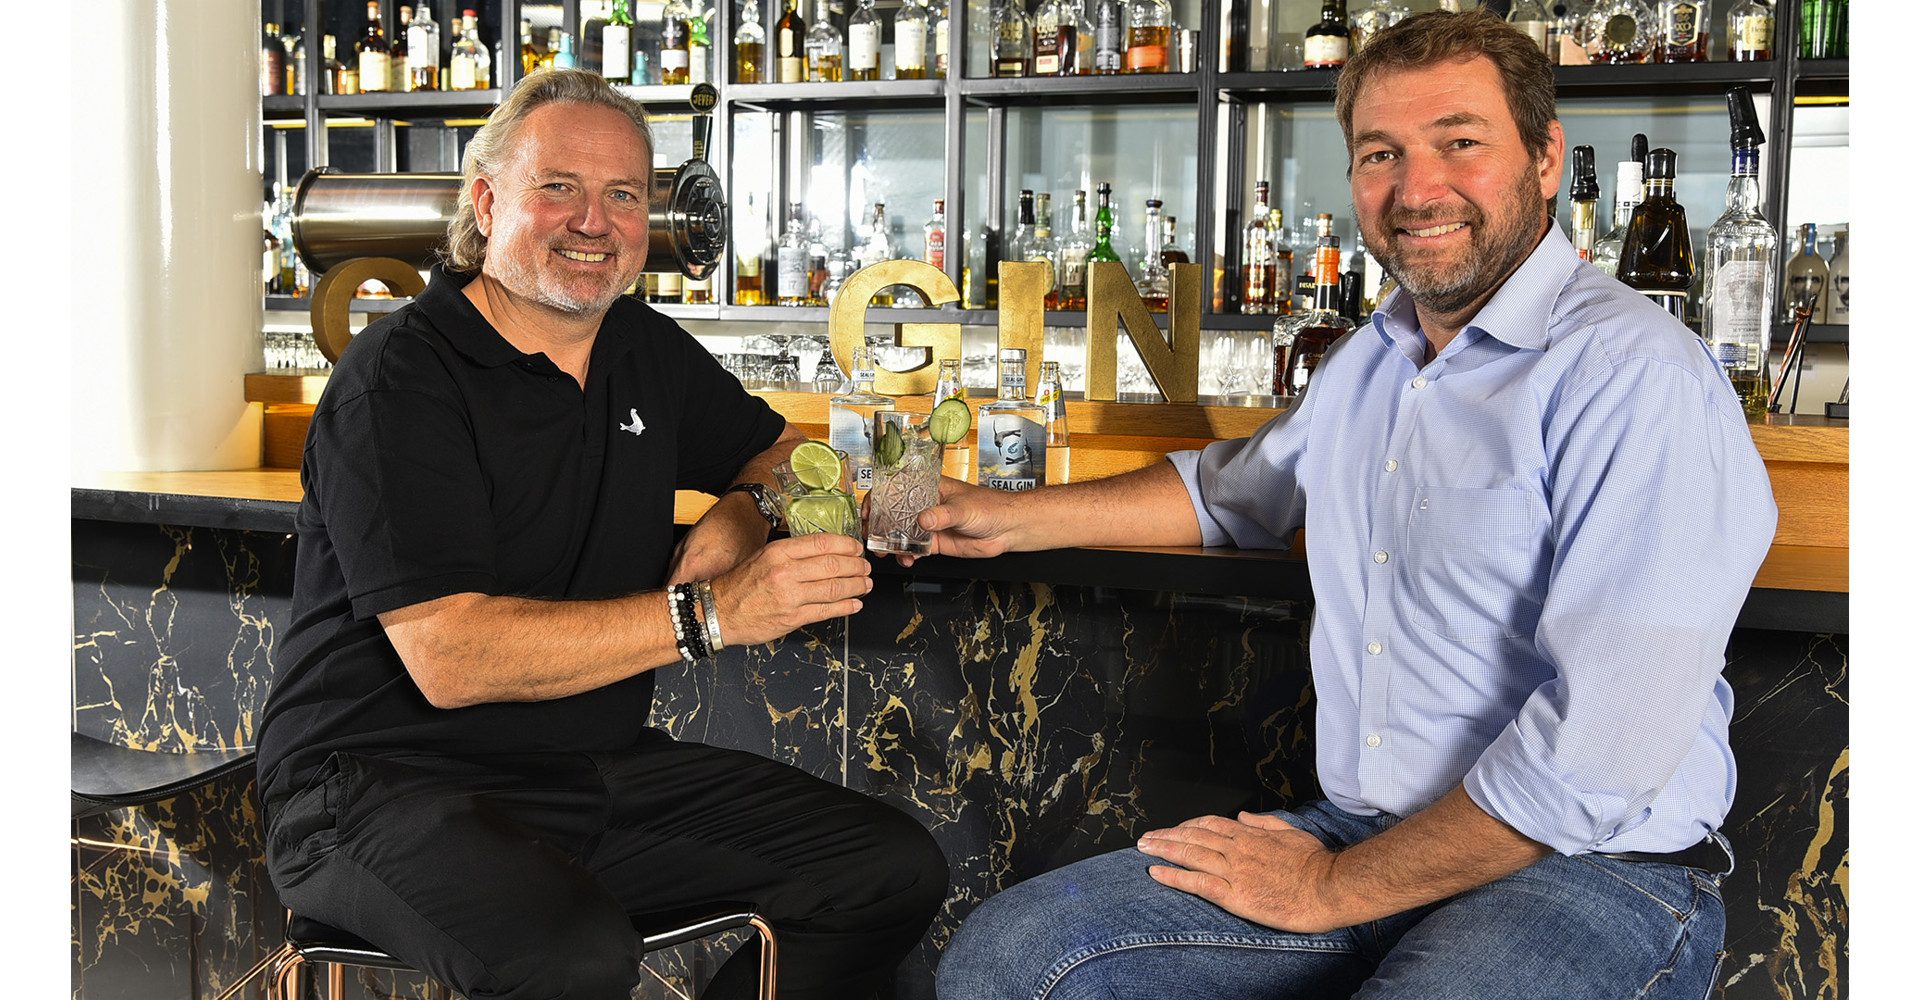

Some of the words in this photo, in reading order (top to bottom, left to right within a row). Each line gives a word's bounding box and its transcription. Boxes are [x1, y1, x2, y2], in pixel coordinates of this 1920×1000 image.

[693, 94, 715, 106] JEVER
[829, 259, 1201, 403] GIN
[992, 480, 1014, 491] SEAL
[1016, 480, 1033, 491] GIN
